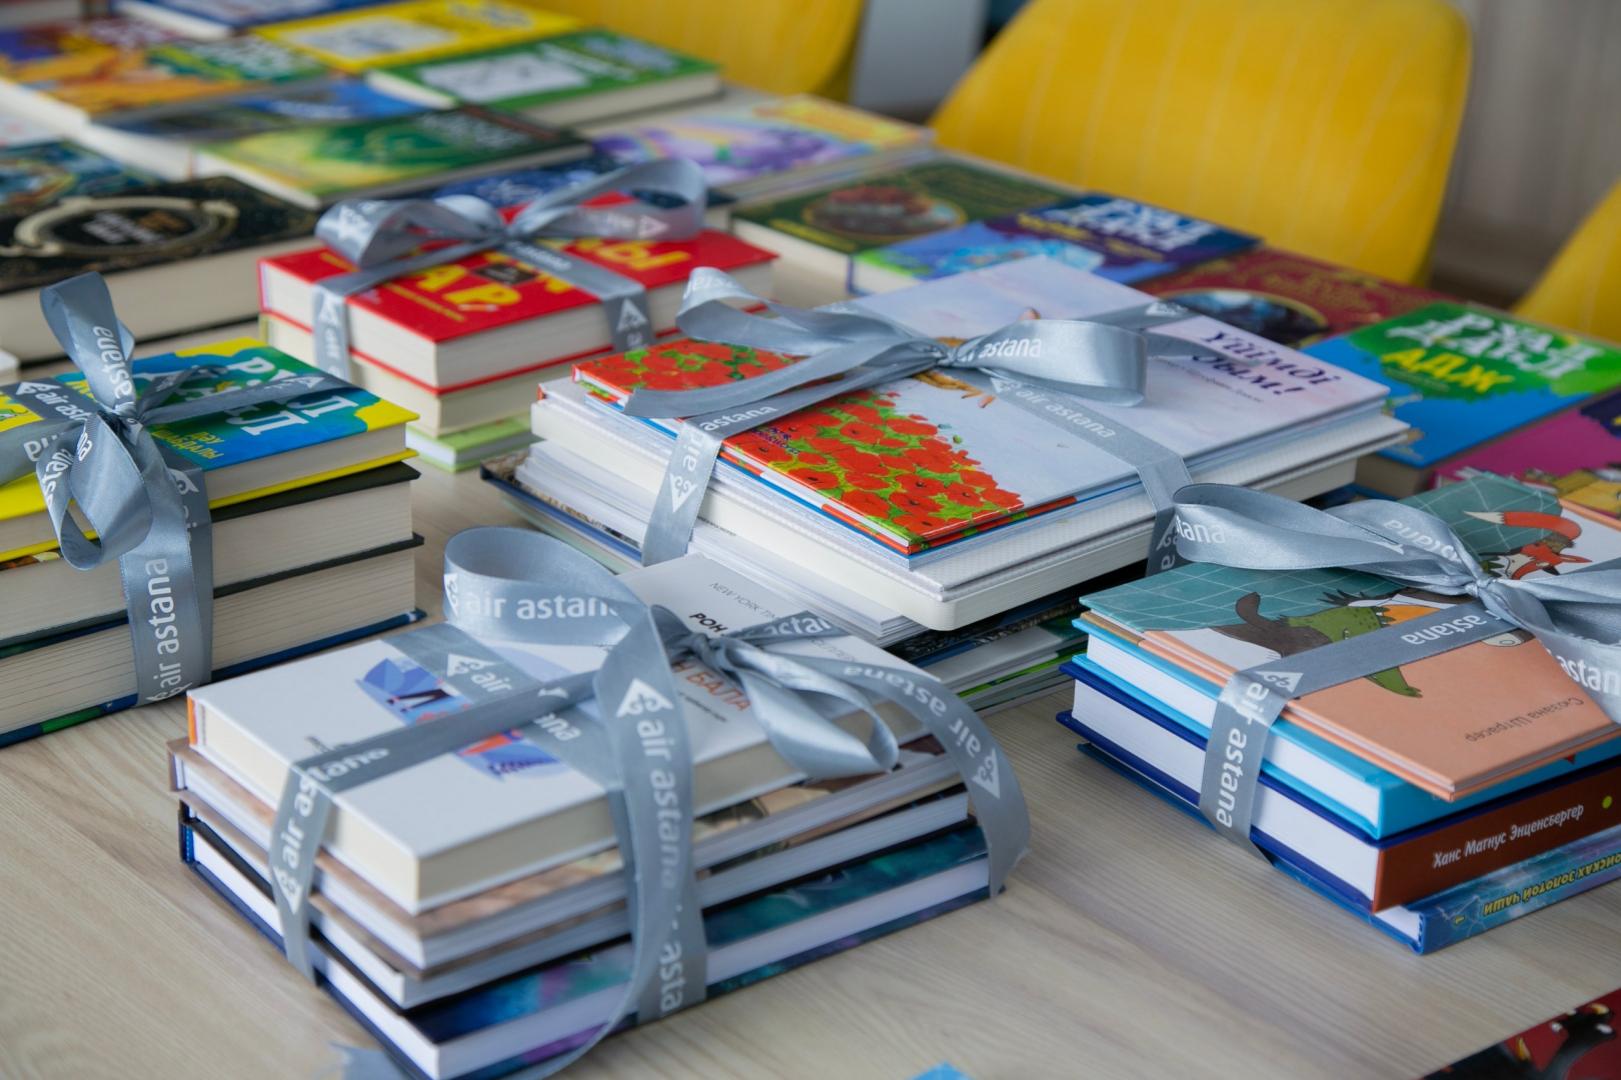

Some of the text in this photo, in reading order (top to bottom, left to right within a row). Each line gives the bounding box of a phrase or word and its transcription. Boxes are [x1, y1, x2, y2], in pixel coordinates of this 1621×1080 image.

[93, 326, 134, 400] astana
[977, 336, 1043, 361] astana
[36, 390, 69, 407] air
[1015, 389, 1117, 439] air astana
[683, 404, 779, 473] air astana
[1174, 515, 1228, 545] tana
[145, 558, 182, 690] air astana
[462, 590, 507, 619] air
[1402, 614, 1488, 647] astana
[470, 669, 514, 694] air
[1555, 655, 1621, 697] astan
[843, 664, 982, 760] air astana
[636, 718, 684, 890] air astana
[1216, 727, 1248, 829] astana
[280, 818, 306, 870] air
[1432, 803, 1585, 870] Ханс Магнус Энценсбергер
[1481, 852, 1621, 917] ОИСКАХ ЗОЛОТОЙ ЧАШИ
